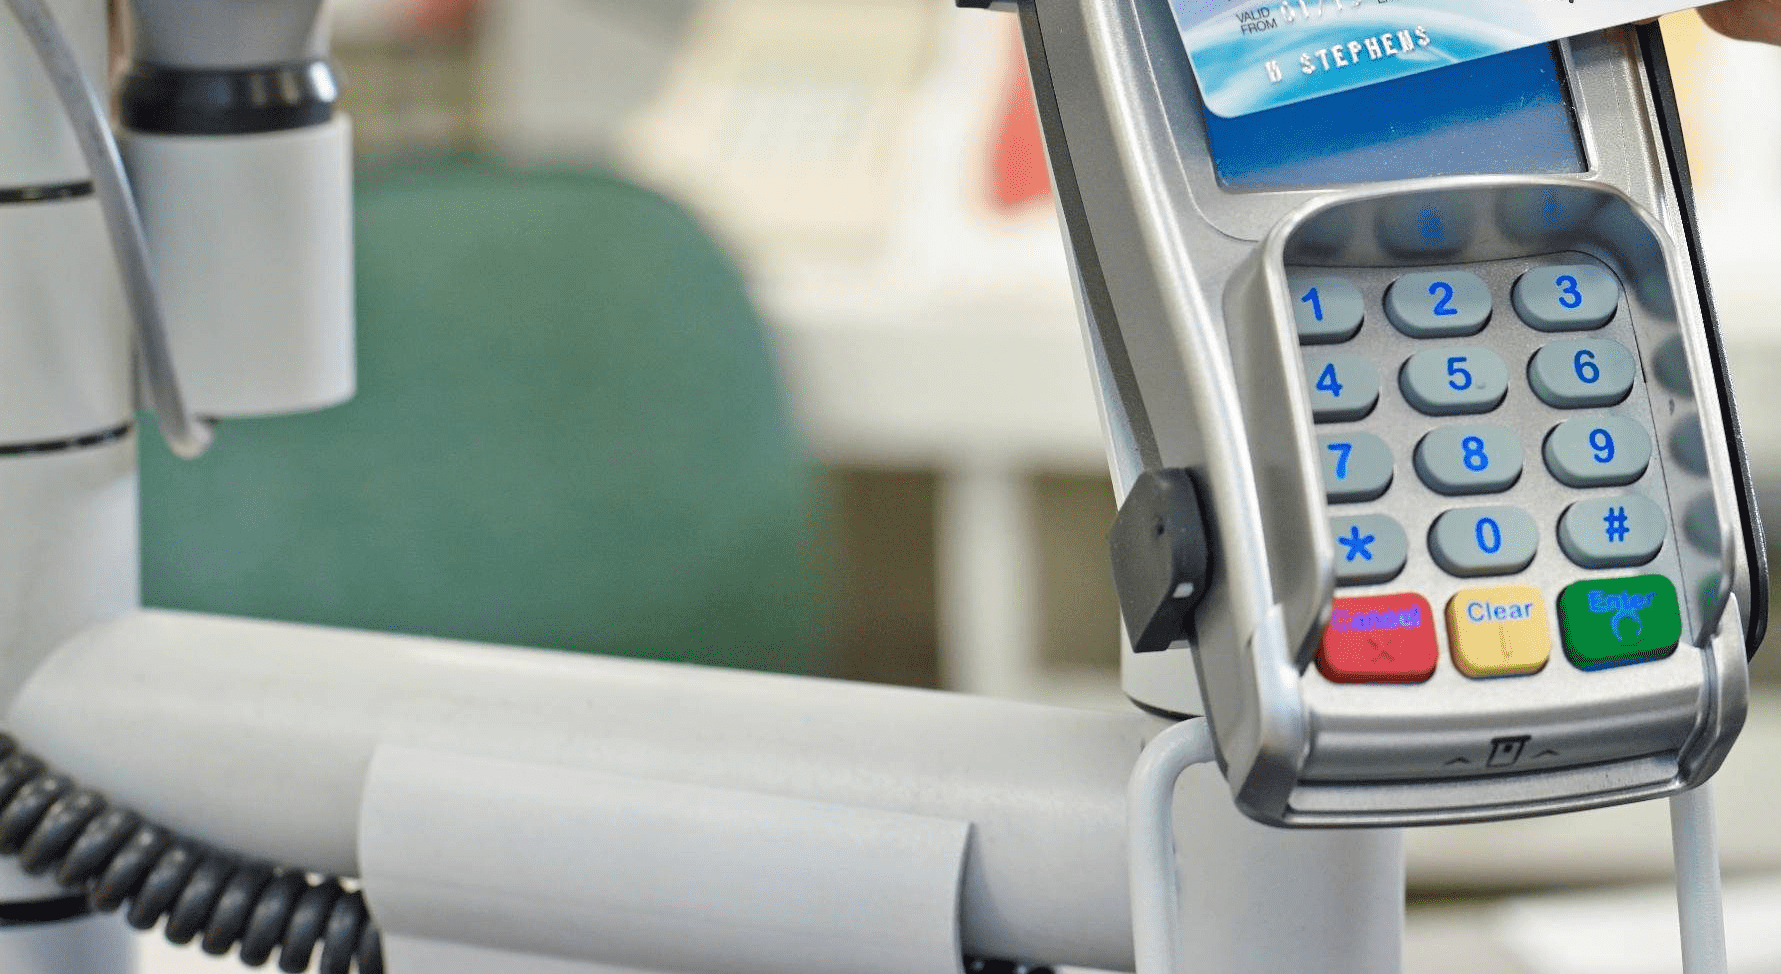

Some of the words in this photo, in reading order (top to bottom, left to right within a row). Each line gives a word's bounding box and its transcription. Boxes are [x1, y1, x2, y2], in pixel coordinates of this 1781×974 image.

[1236, 5, 1270, 24] VALID
[1240, 18, 1278, 36] FROM
[1300, 25, 1432, 76] STEPHENS
[1301, 287, 1323, 322] 1
[1427, 280, 1458, 317] 2
[1555, 275, 1583, 311] 3
[1315, 362, 1343, 398] 4
[1446, 356, 1473, 392] 5
[1573, 349, 1600, 385] 6
[1327, 441, 1353, 480] 7
[1461, 435, 1489, 473] 8
[1588, 428, 1616, 464] 9
[1474, 516, 1502, 555] 0
[1603, 506, 1630, 543] #
[1467, 600, 1534, 624] Clear
[1587, 589, 1657, 614] Enter
